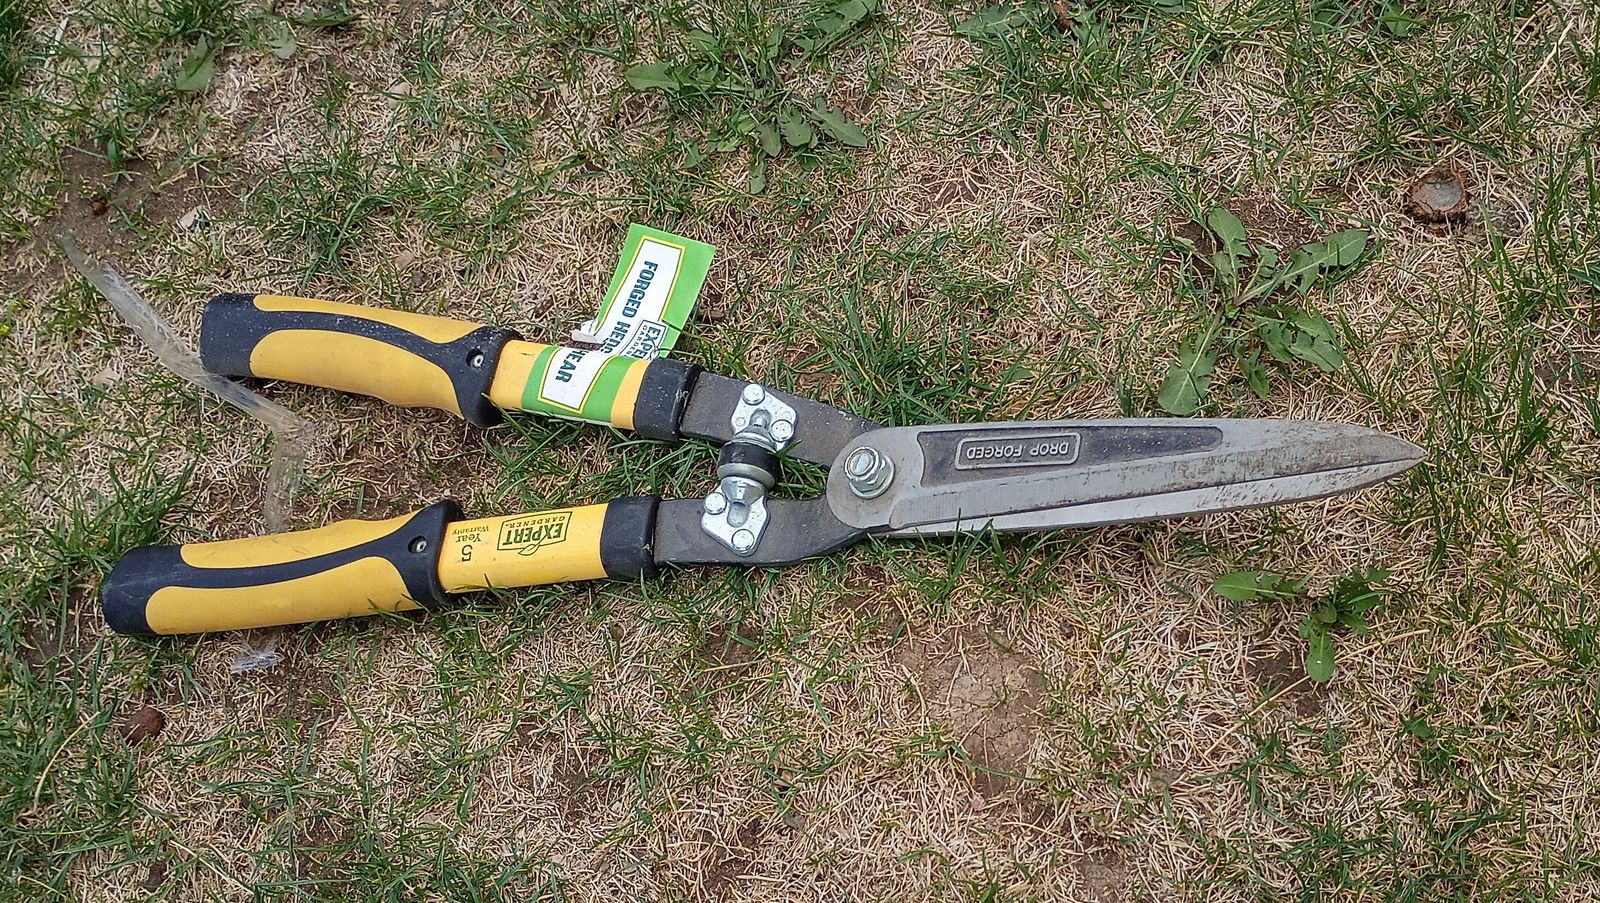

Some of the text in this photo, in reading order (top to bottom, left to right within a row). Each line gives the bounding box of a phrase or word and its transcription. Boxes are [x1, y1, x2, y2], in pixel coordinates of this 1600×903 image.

[622, 260, 659, 318] FORGED
[630, 326, 661, 359] EXPE
[966, 442, 1069, 460] DROP FORGED
[452, 525, 489, 535] Warranty
[455, 533, 483, 543] Year
[502, 522, 564, 546] EXPERT
[461, 544, 474, 562] 5
